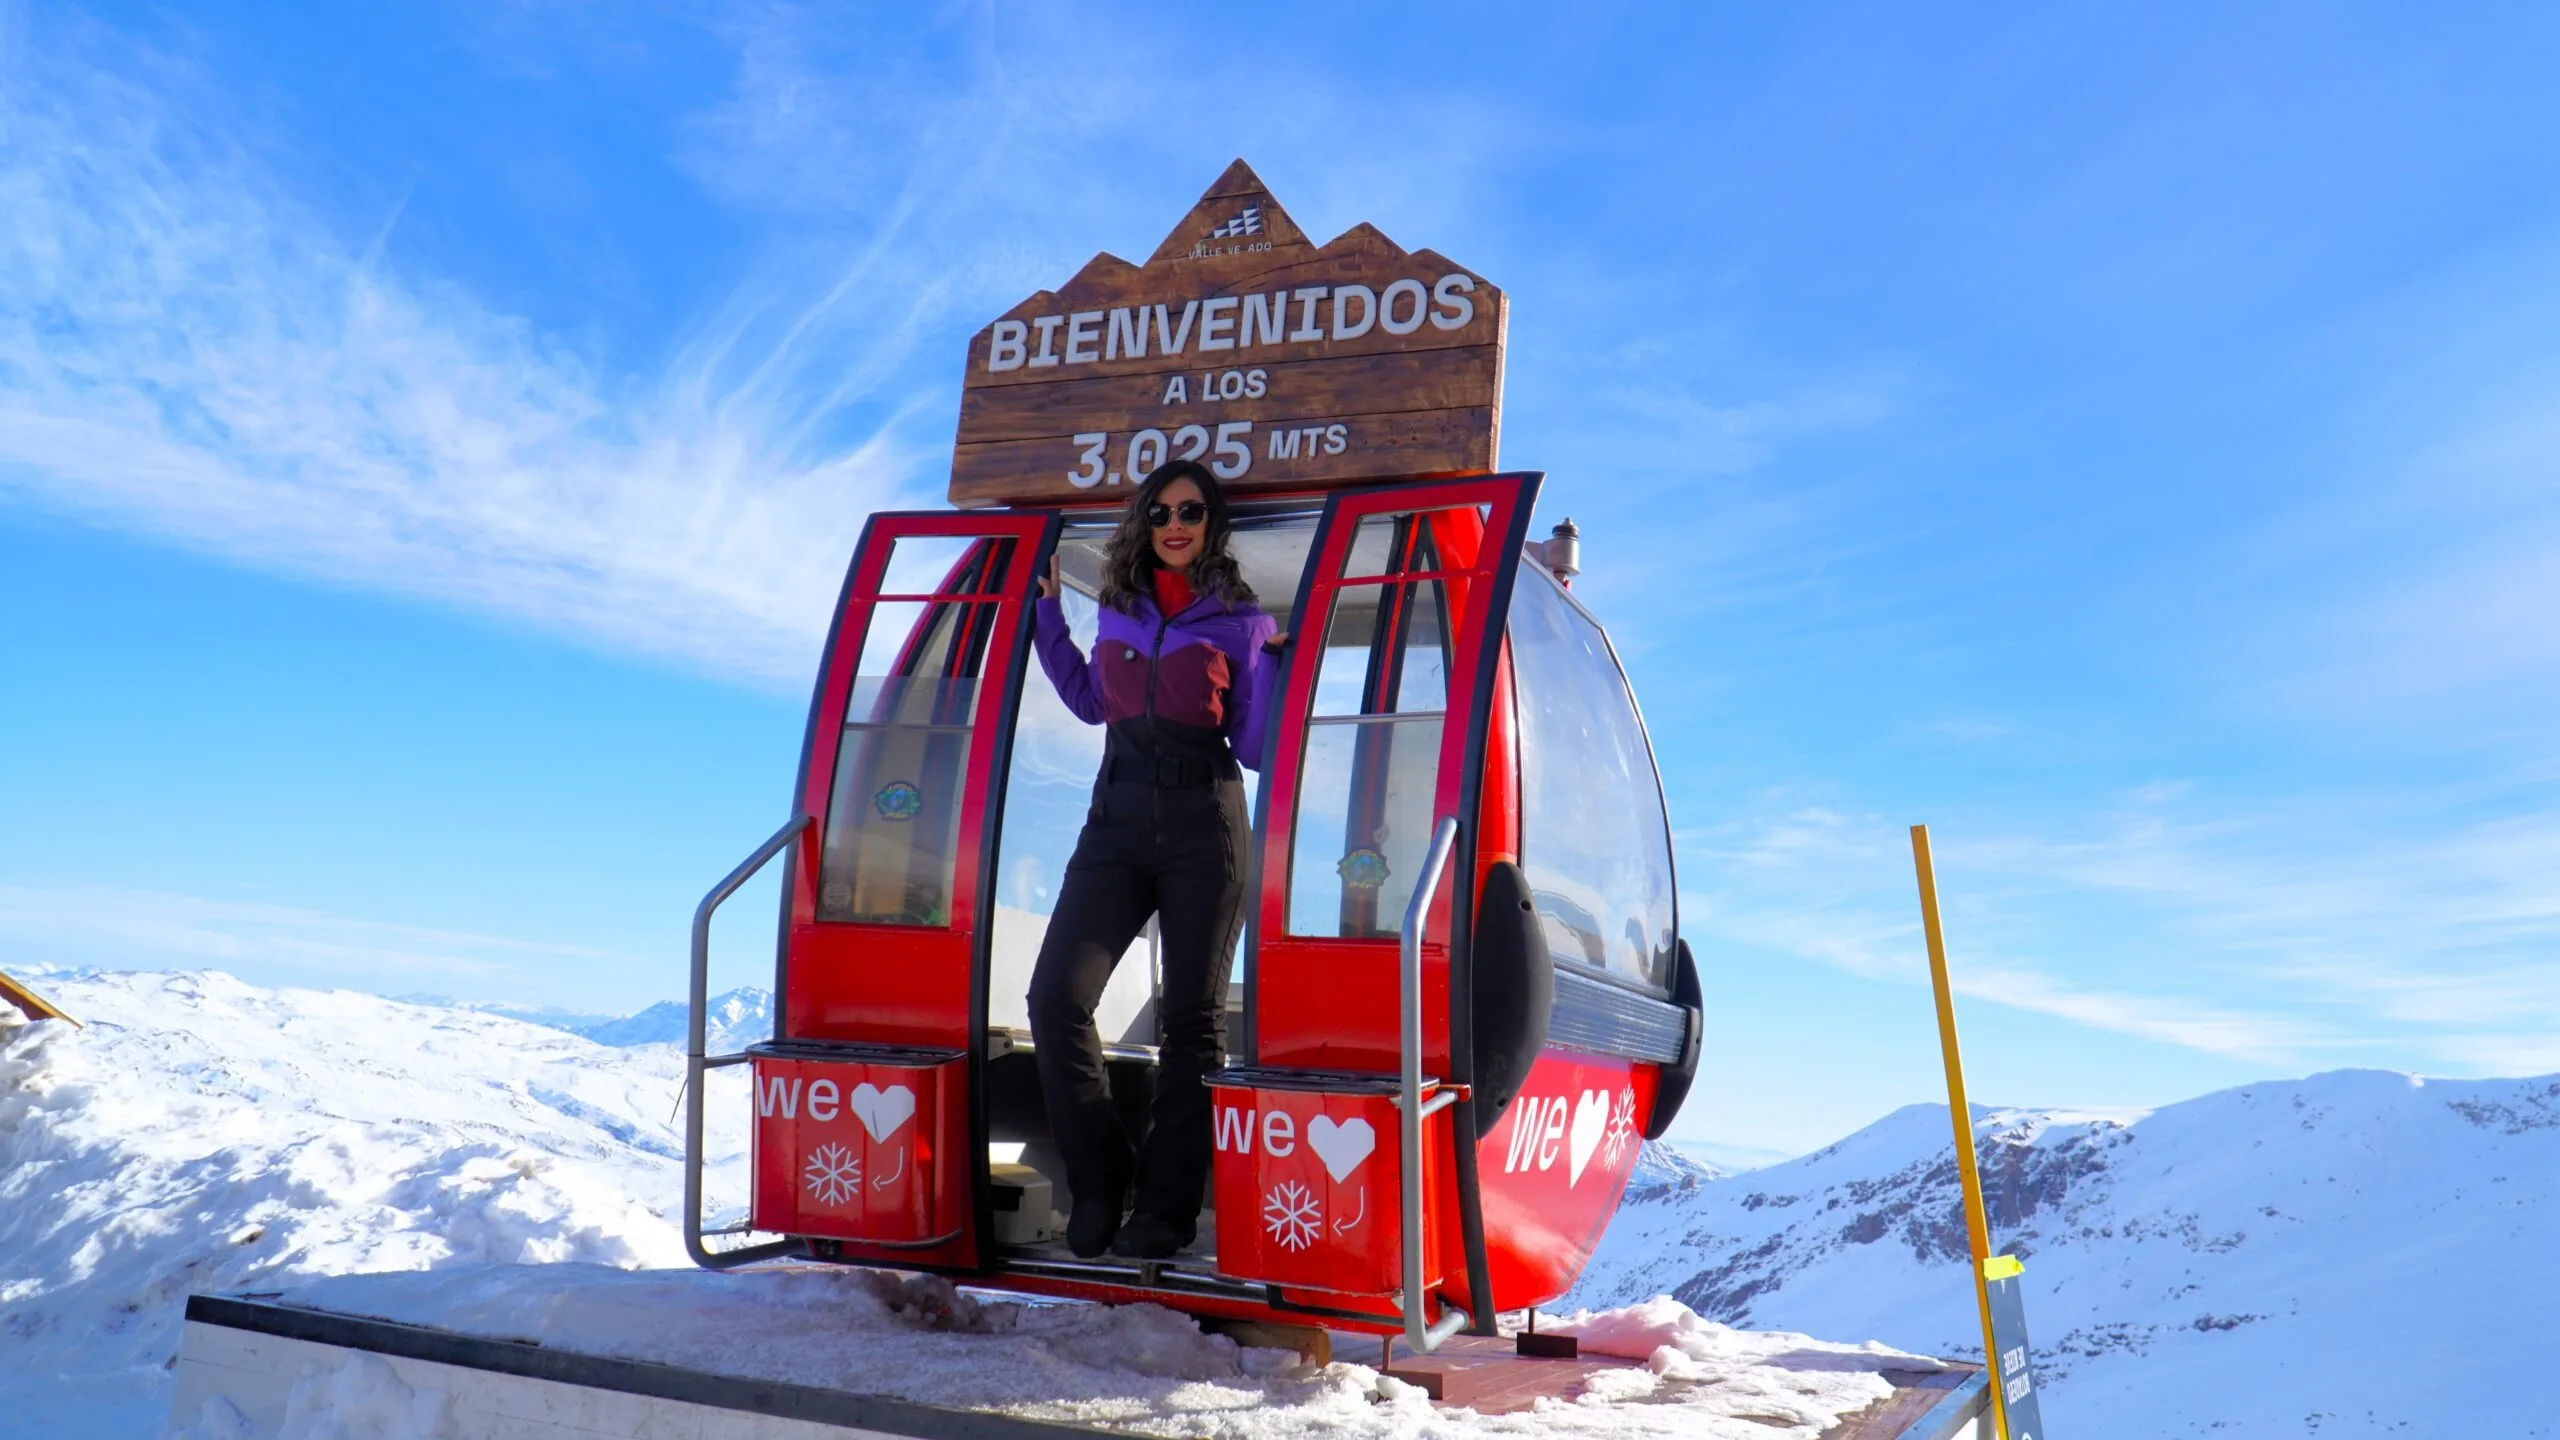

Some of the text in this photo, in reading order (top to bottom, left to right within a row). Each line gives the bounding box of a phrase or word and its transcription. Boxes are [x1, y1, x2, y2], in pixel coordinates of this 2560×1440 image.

[1188, 247, 1222, 260] VALLE
[988, 273, 1476, 373] BIENVENIDOS
[1163, 369, 1268, 405] A LOS
[1067, 421, 1348, 489] 3.025 MTS
[757, 1075, 840, 1122] we
[1214, 1104, 1296, 1158] we
[1504, 1095, 1568, 1173] we
